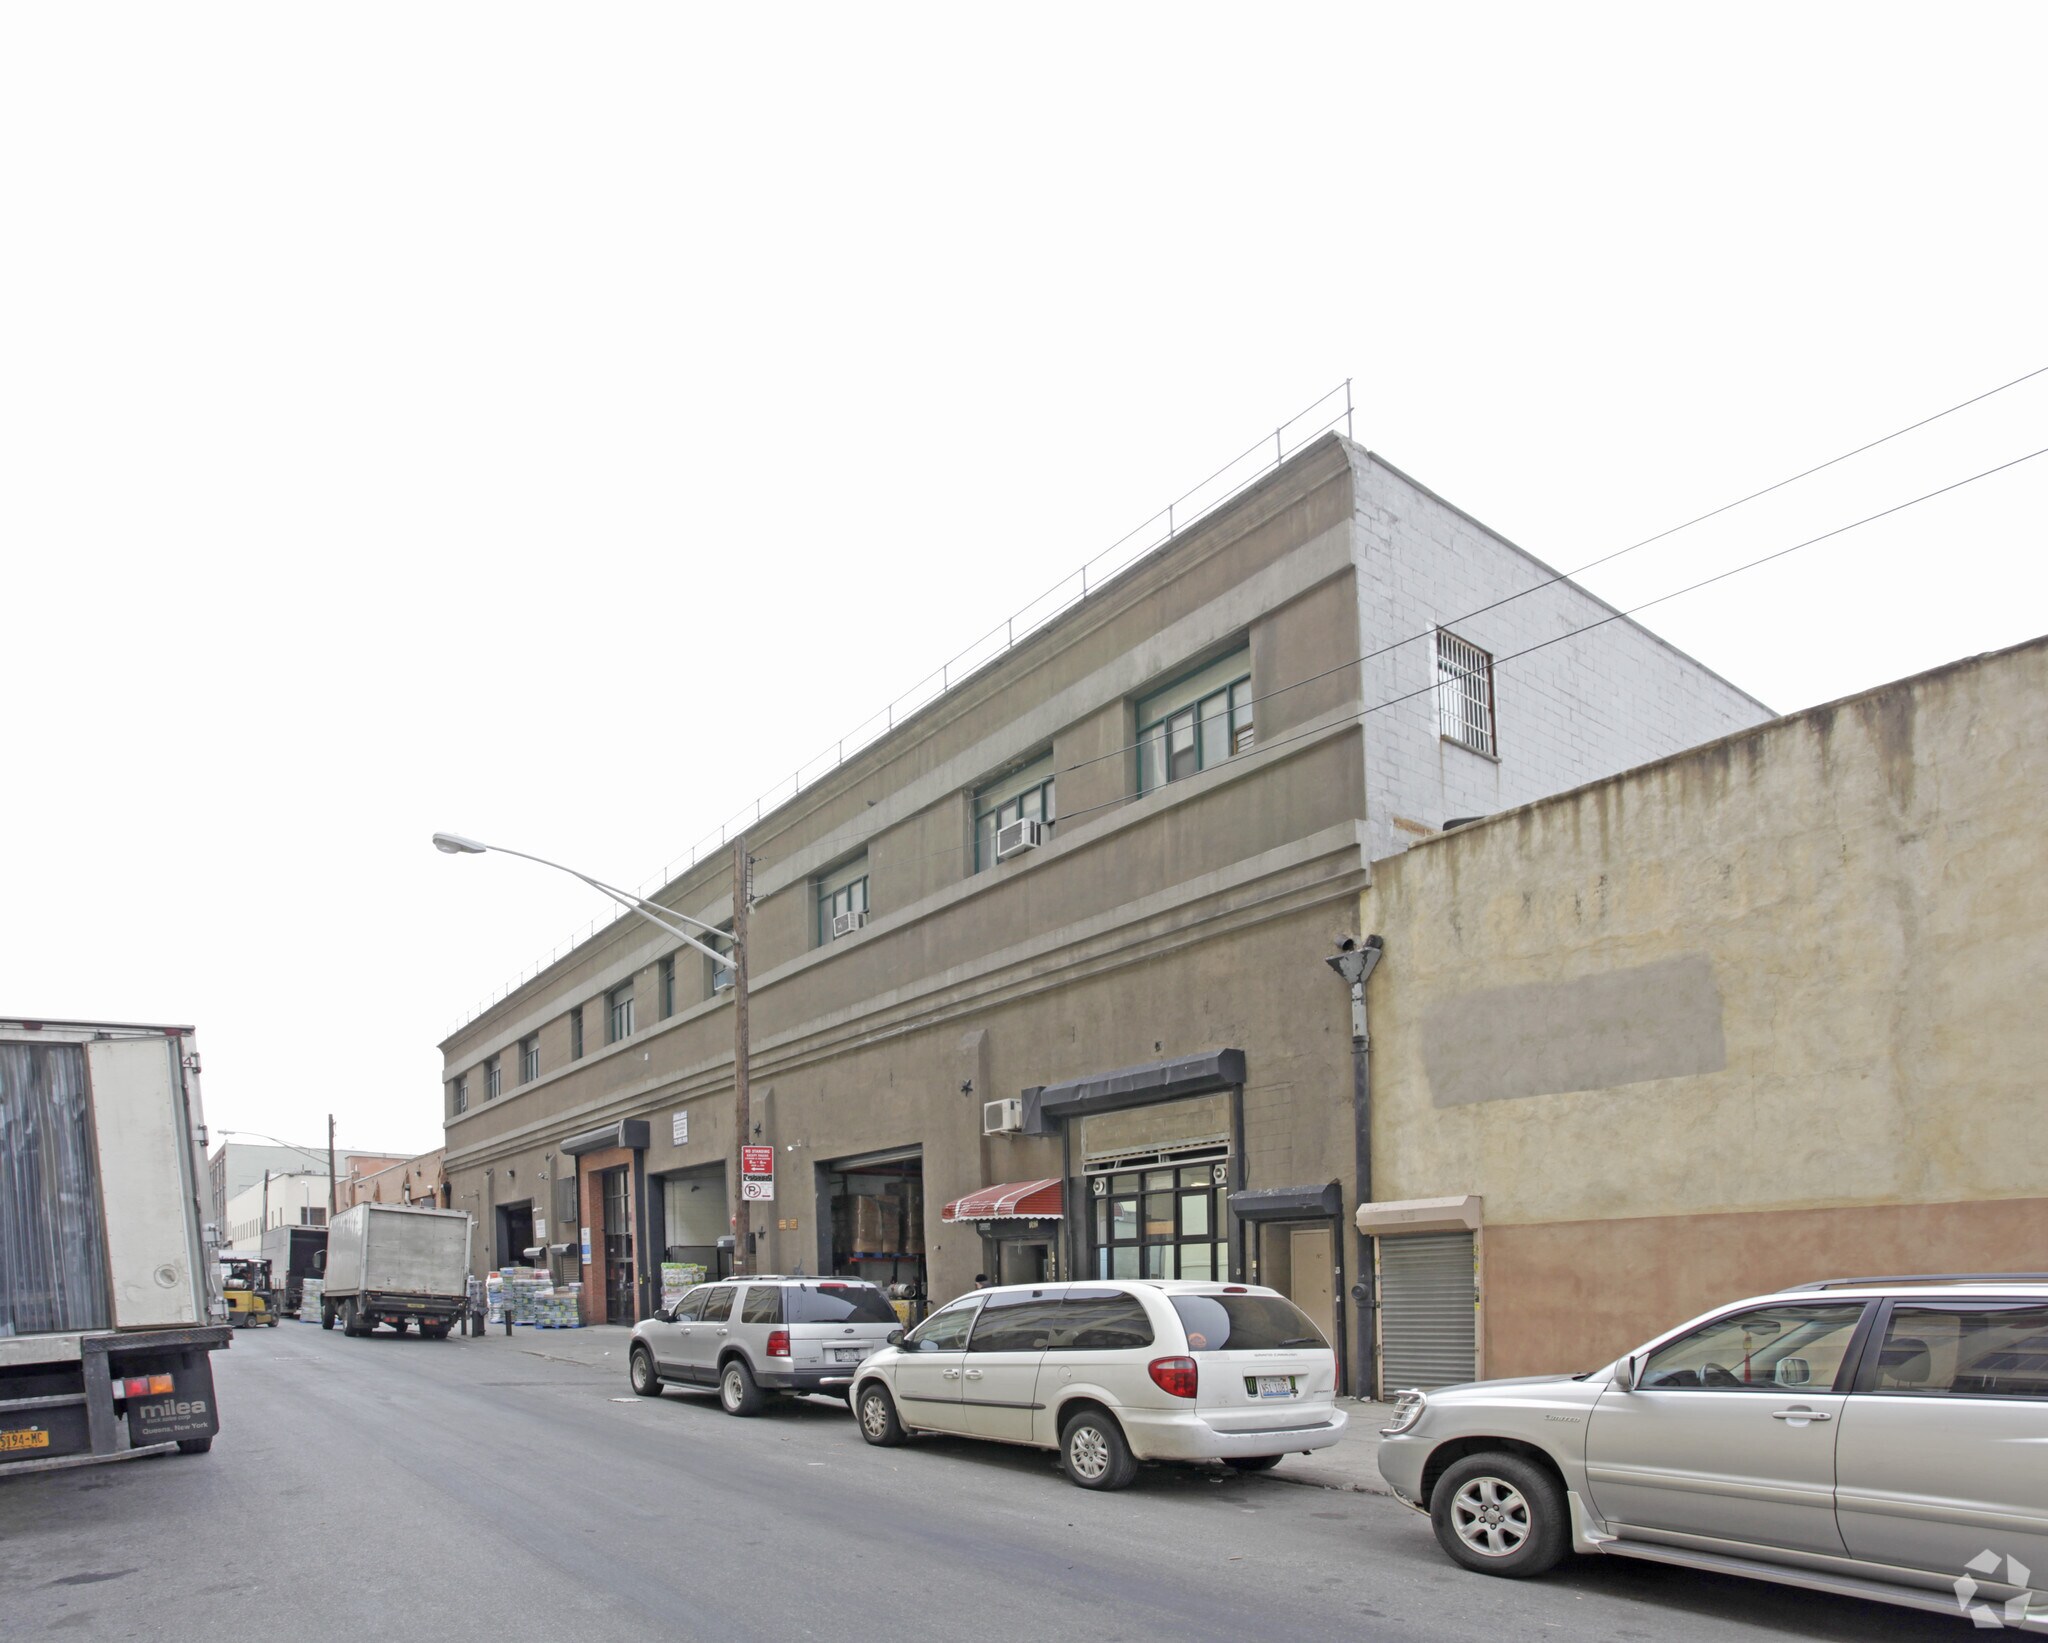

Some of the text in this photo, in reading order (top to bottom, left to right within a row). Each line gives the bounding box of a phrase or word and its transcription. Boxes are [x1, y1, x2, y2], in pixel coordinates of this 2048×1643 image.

[140, 1399, 207, 1419] milea
[142, 1427, 174, 1435] Queens,
[191, 1421, 209, 1429] York
